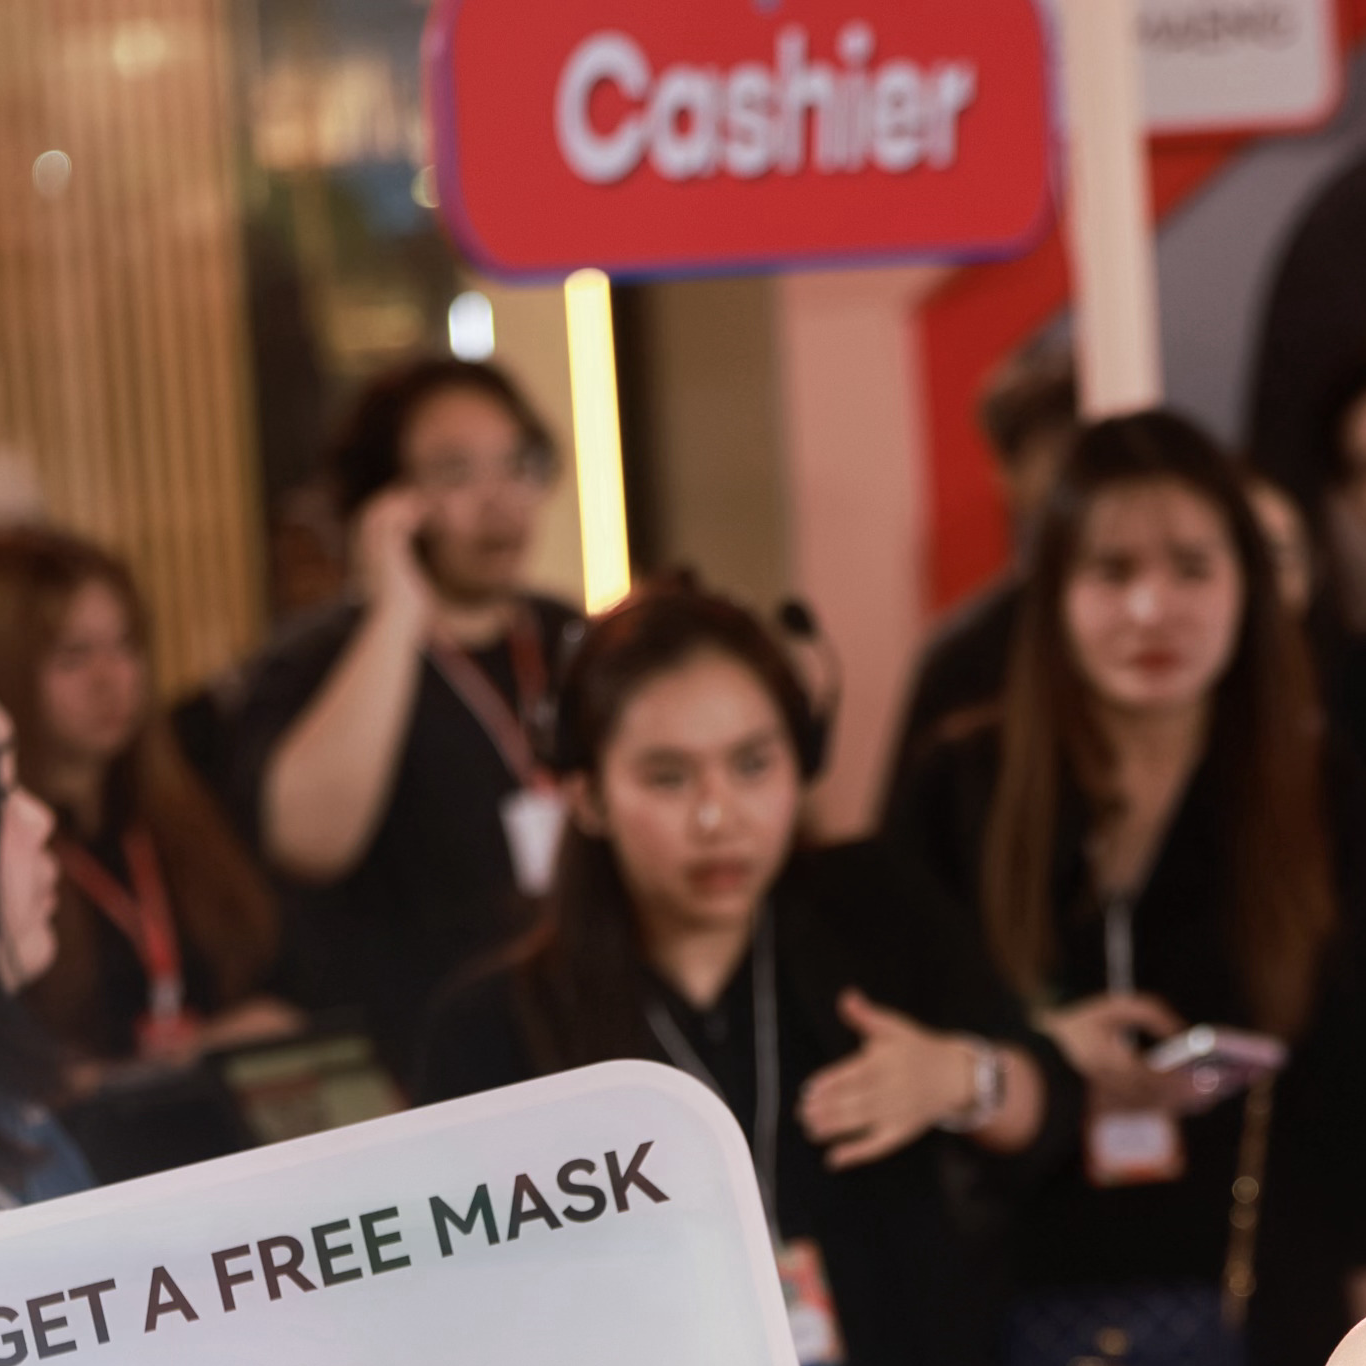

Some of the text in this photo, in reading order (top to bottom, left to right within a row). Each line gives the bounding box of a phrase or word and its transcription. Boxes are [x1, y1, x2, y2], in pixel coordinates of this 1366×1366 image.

[554, 24, 974, 185] Cashier
[143, 1266, 200, 1332] A
[211, 1207, 412, 1312] FREE
[429, 1140, 671, 1258] MASK
